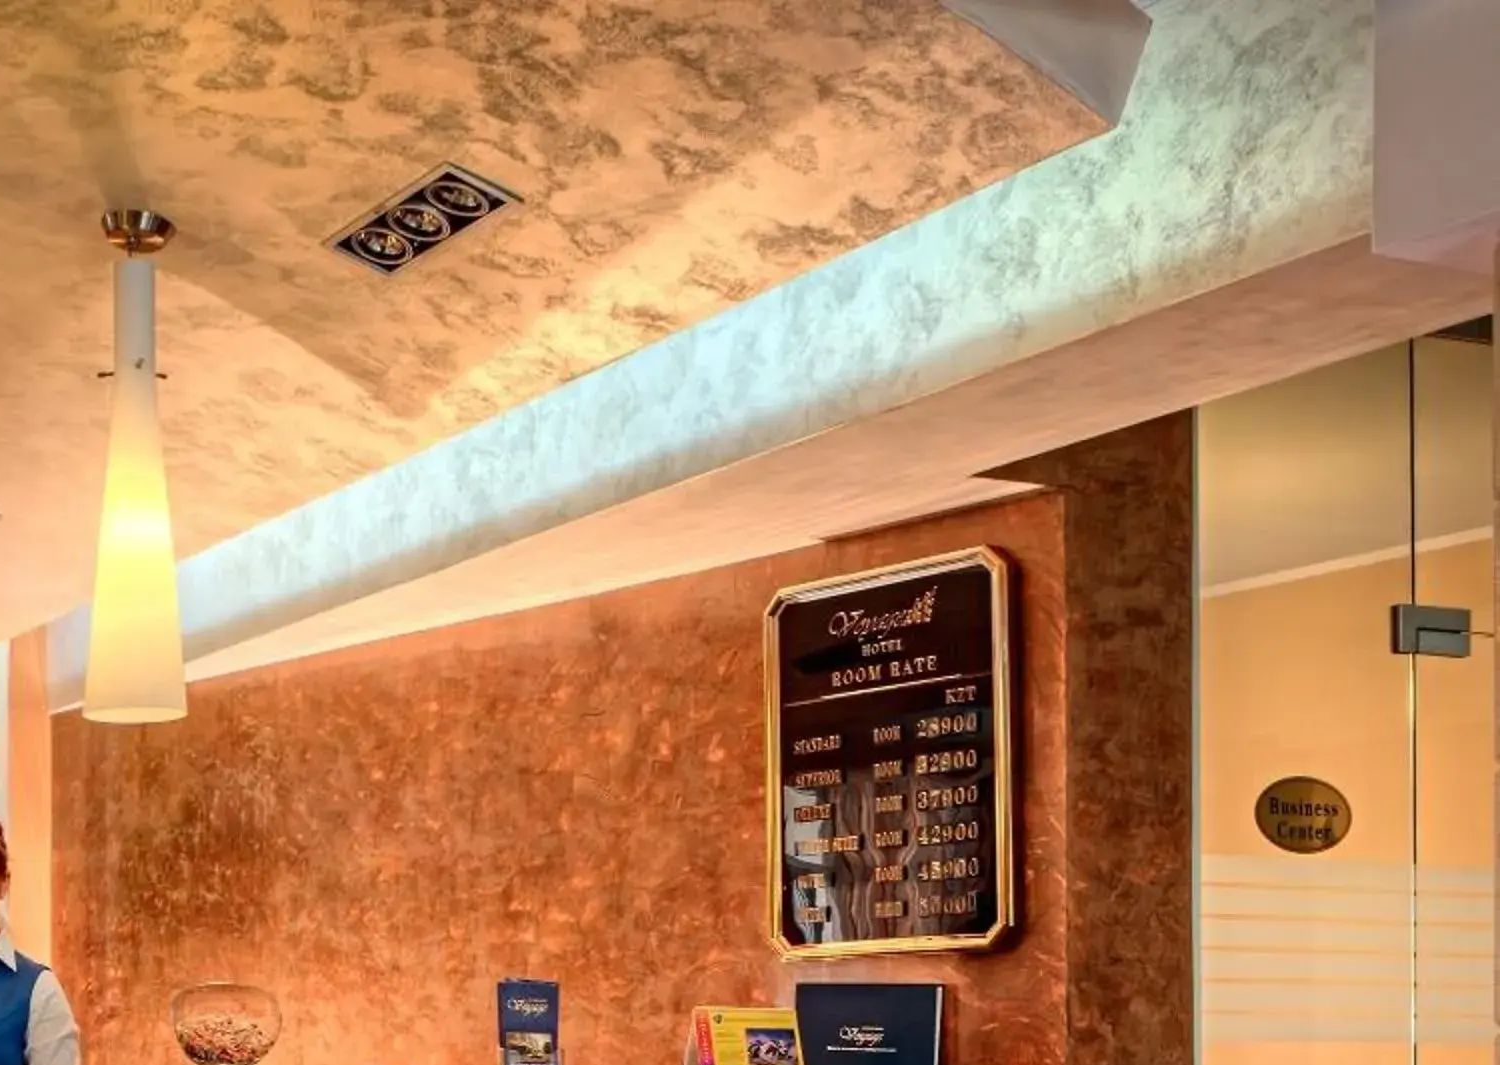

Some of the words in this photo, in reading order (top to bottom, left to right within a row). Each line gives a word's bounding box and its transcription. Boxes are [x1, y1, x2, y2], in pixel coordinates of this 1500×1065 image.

[861, 639, 903, 656] HOTEL
[832, 664, 881, 687] ROOM
[890, 655, 937, 678] RATE
[944, 686, 977, 704] KZT
[1269, 797, 1339, 817] Business
[1276, 820, 1333, 842] Center
